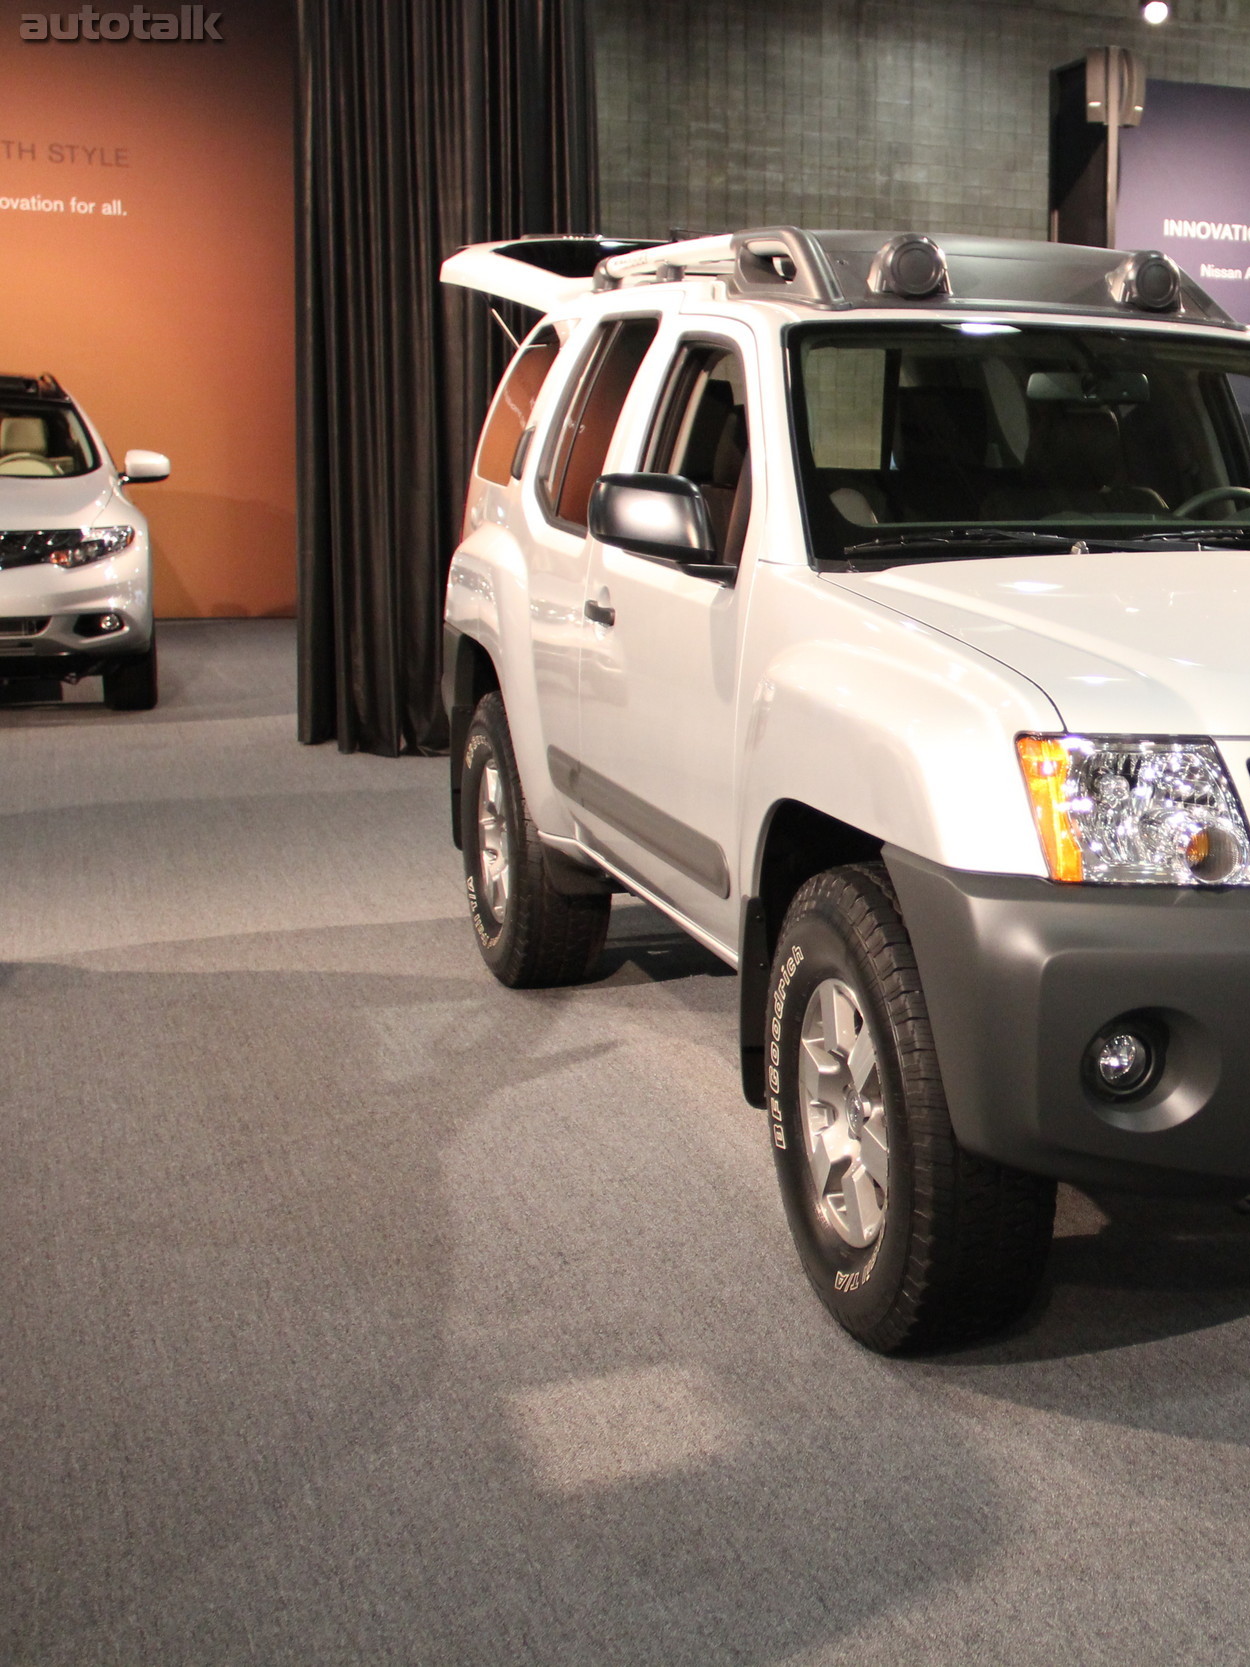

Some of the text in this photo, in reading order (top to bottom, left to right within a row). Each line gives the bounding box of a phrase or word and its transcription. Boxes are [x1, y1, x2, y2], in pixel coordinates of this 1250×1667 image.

[48, 143, 130, 168] STYLE
[70, 196, 96, 213] for
[101, 199, 128, 216] all.
[1200, 264, 1242, 280] Nissan
